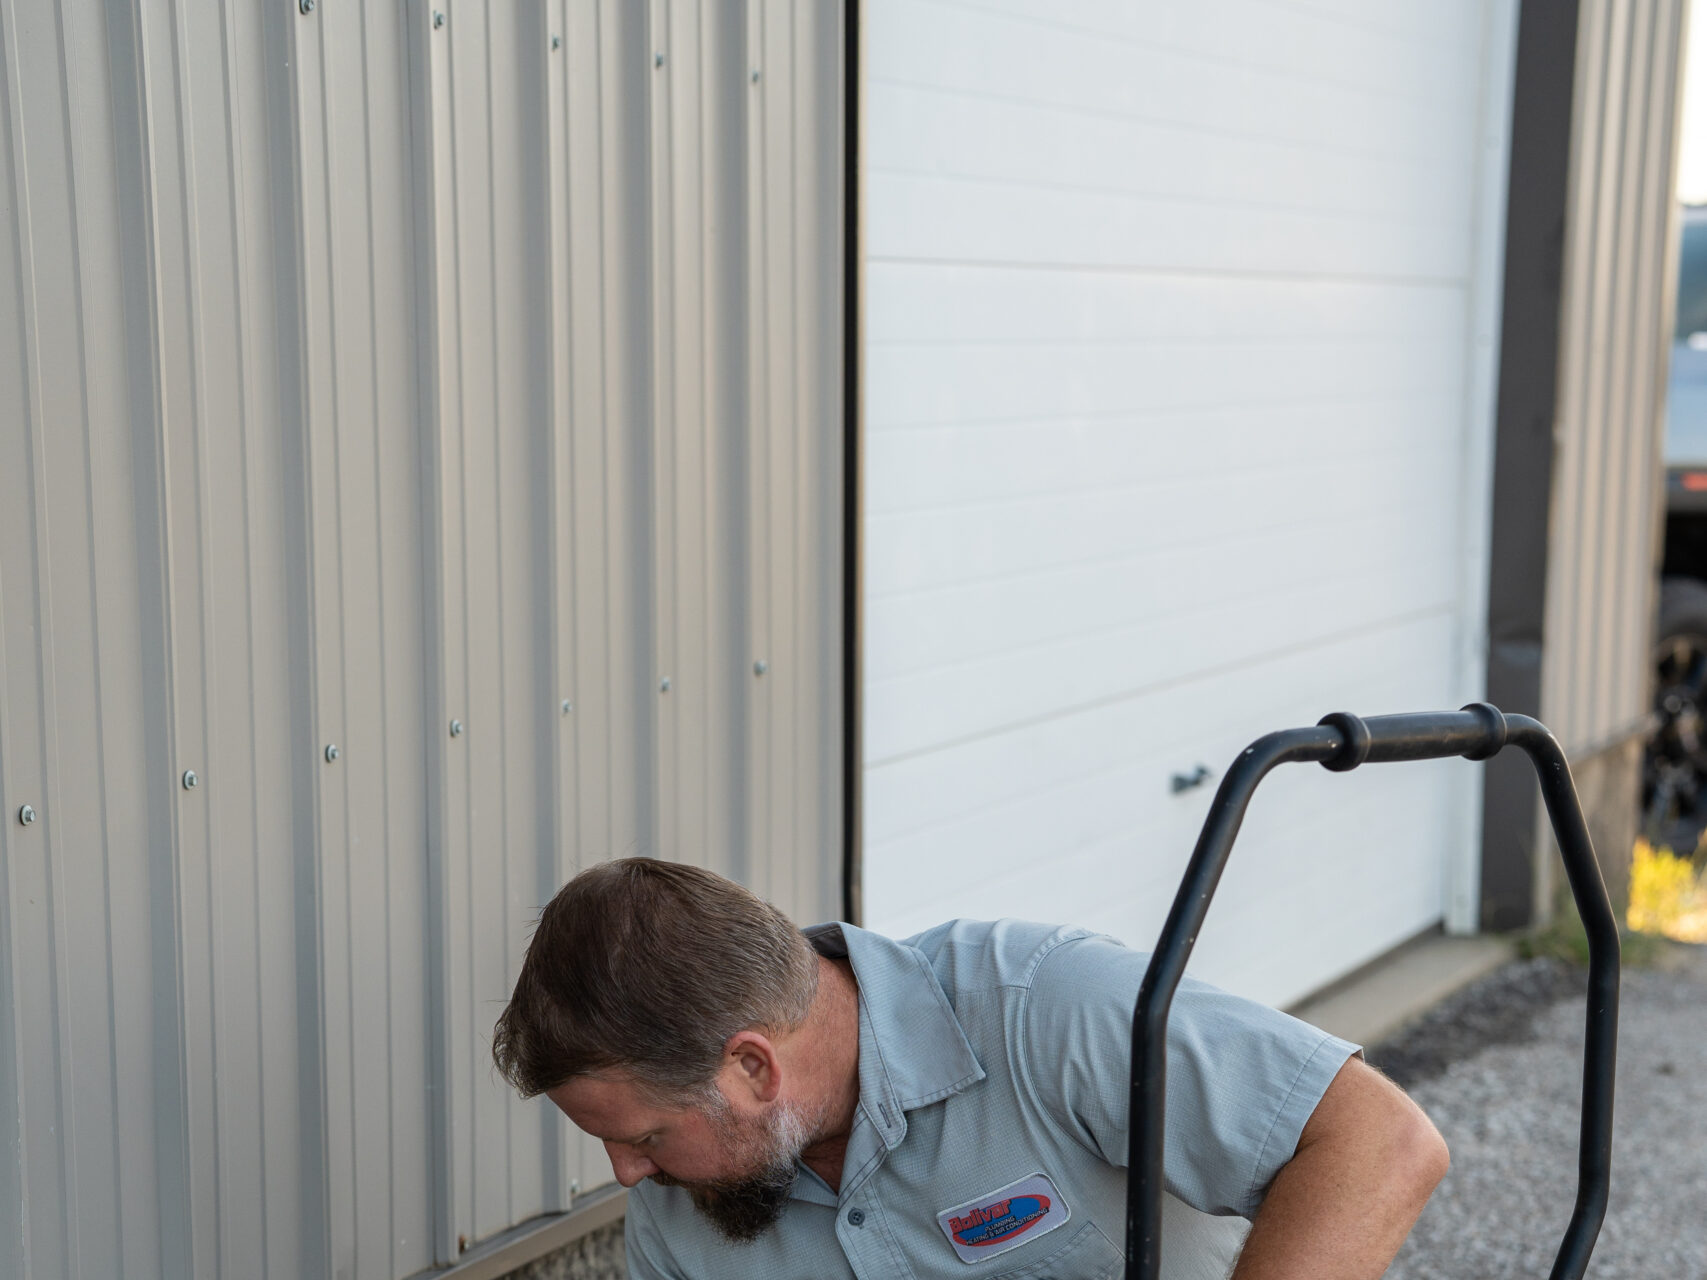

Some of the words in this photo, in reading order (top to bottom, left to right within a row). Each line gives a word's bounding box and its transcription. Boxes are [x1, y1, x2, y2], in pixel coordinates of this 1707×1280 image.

[948, 1199, 1012, 1234] Bolivar
[984, 1215, 1016, 1232] PLUMBING
[995, 1226, 1005, 1236] AIR
[1005, 1207, 1048, 1231] CONDITIONING
